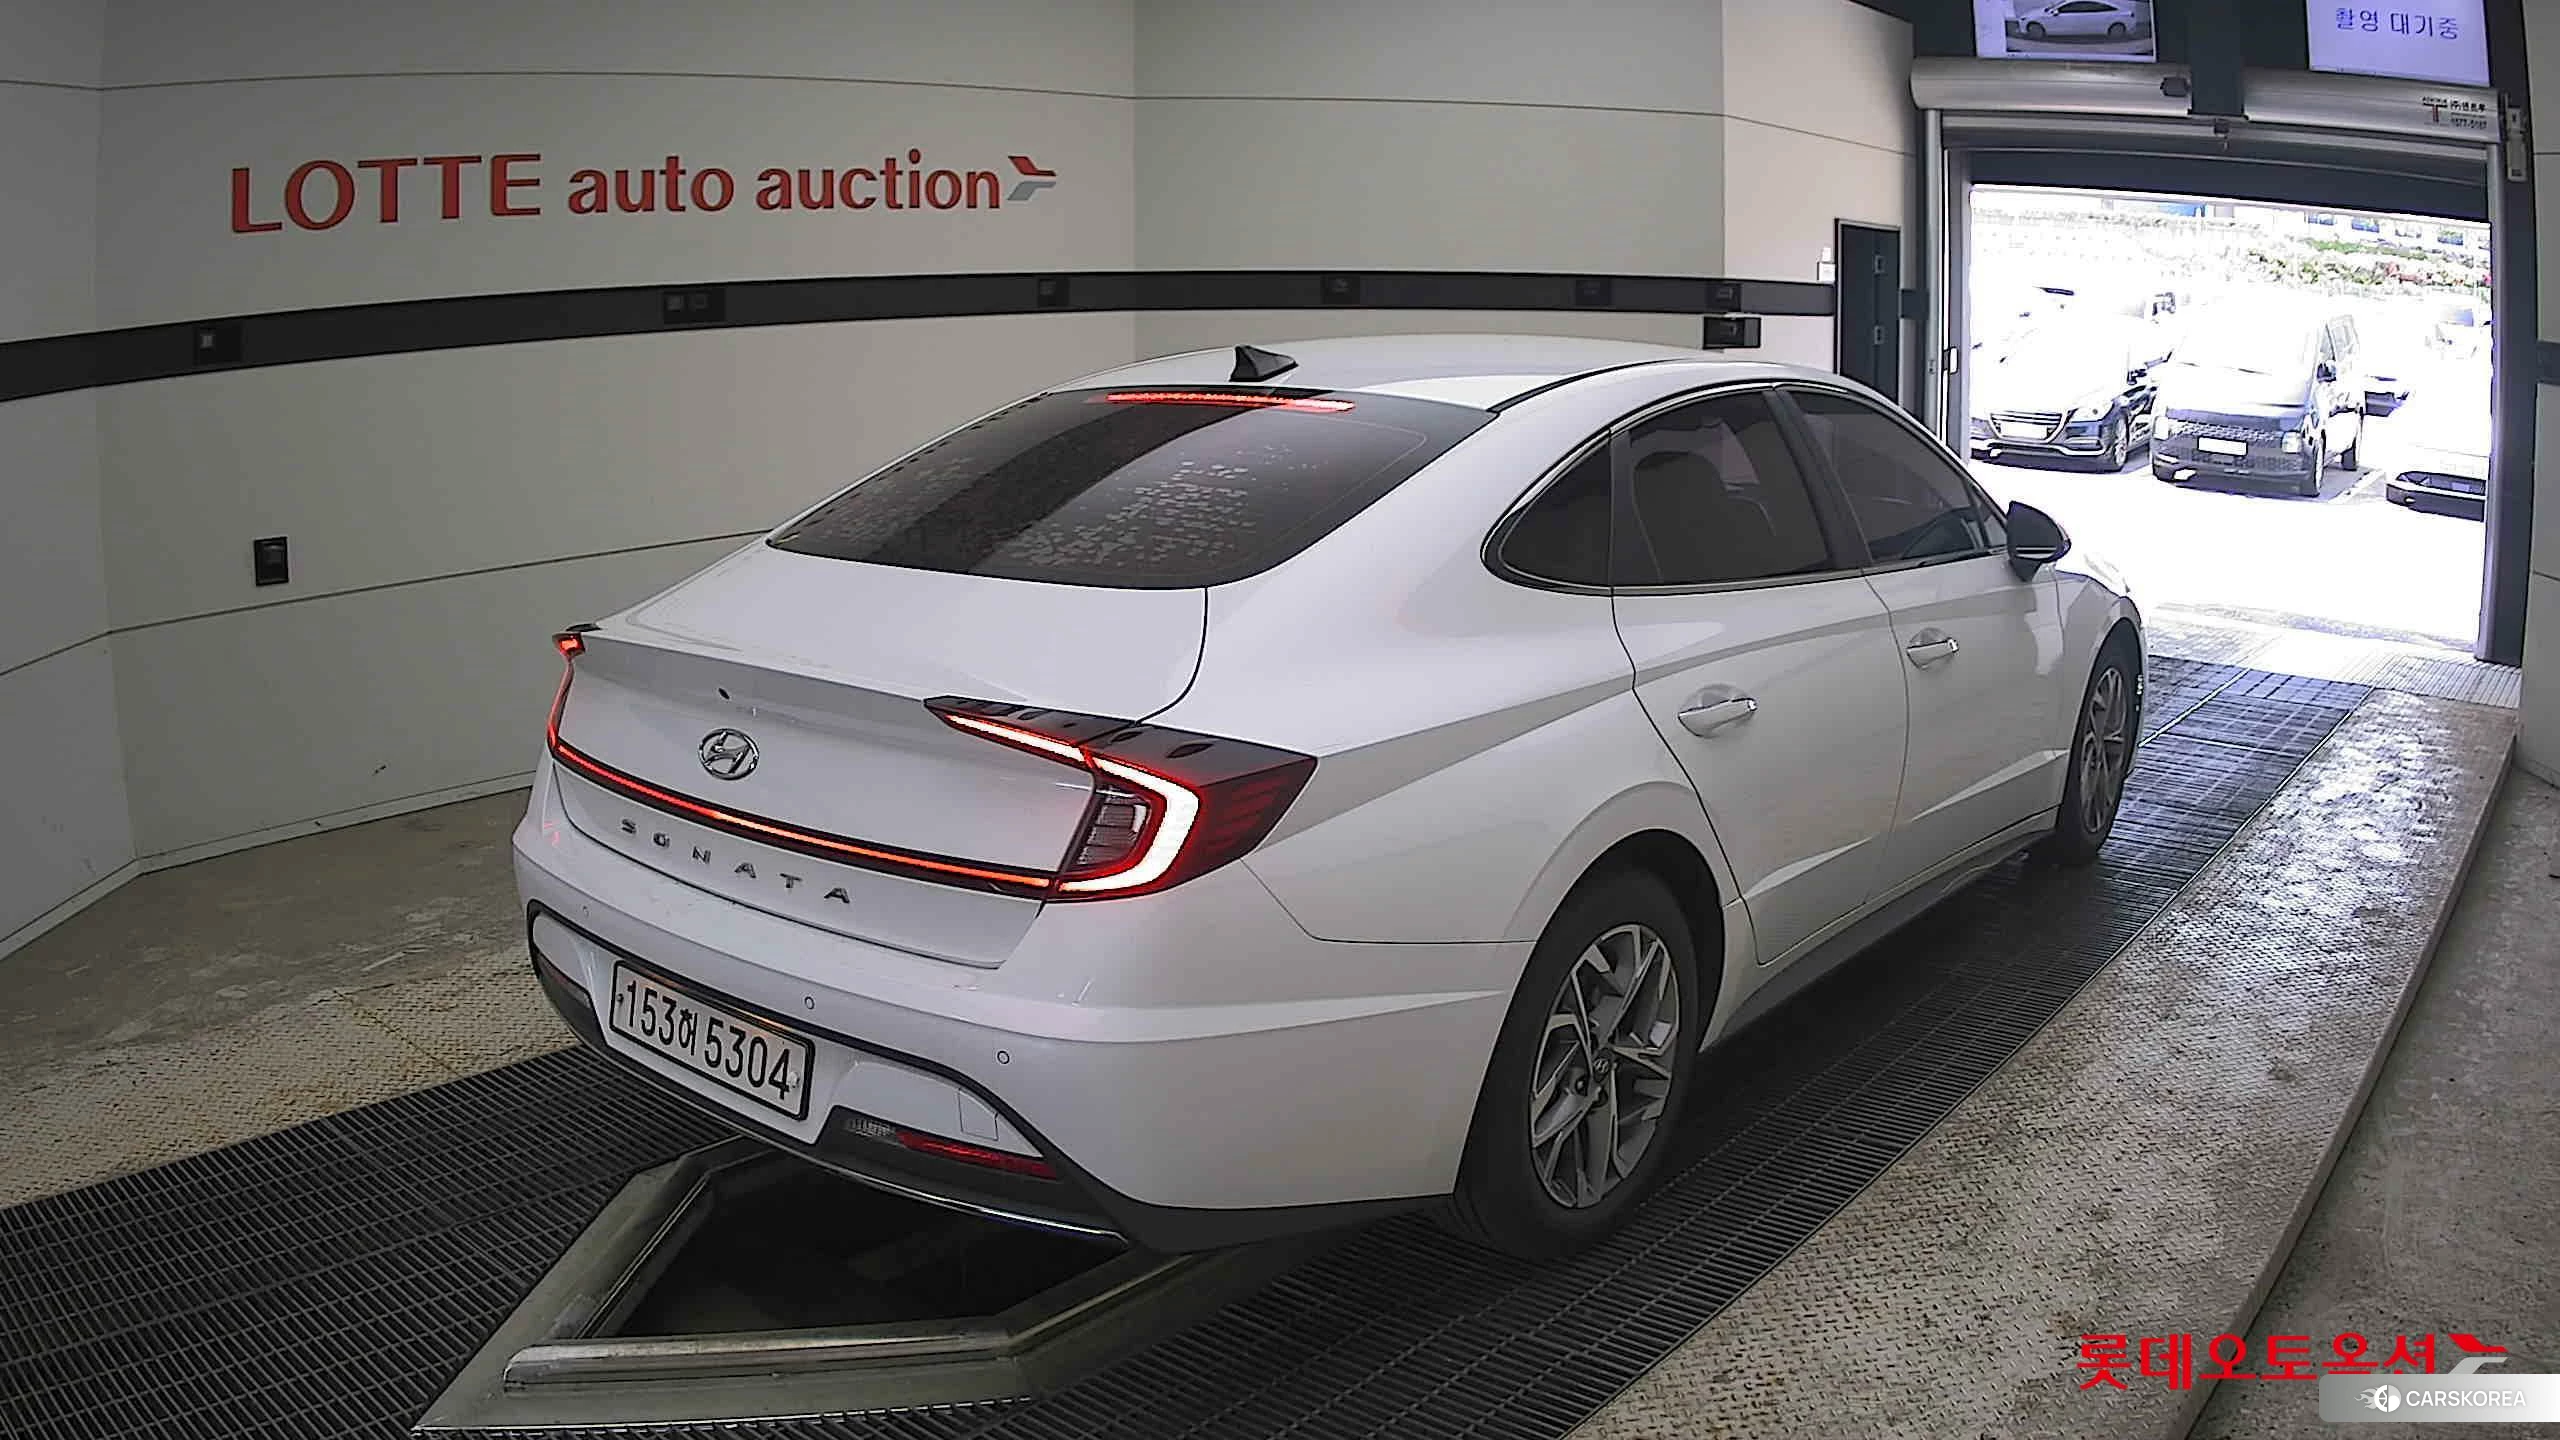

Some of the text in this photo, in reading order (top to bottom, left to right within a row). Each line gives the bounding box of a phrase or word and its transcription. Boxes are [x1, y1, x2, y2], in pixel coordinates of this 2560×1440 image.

[2336, 8, 2379, 32] 촬영
[231, 148, 1002, 234] LOTTE auto auction
[620, 818, 851, 904] SONATA
